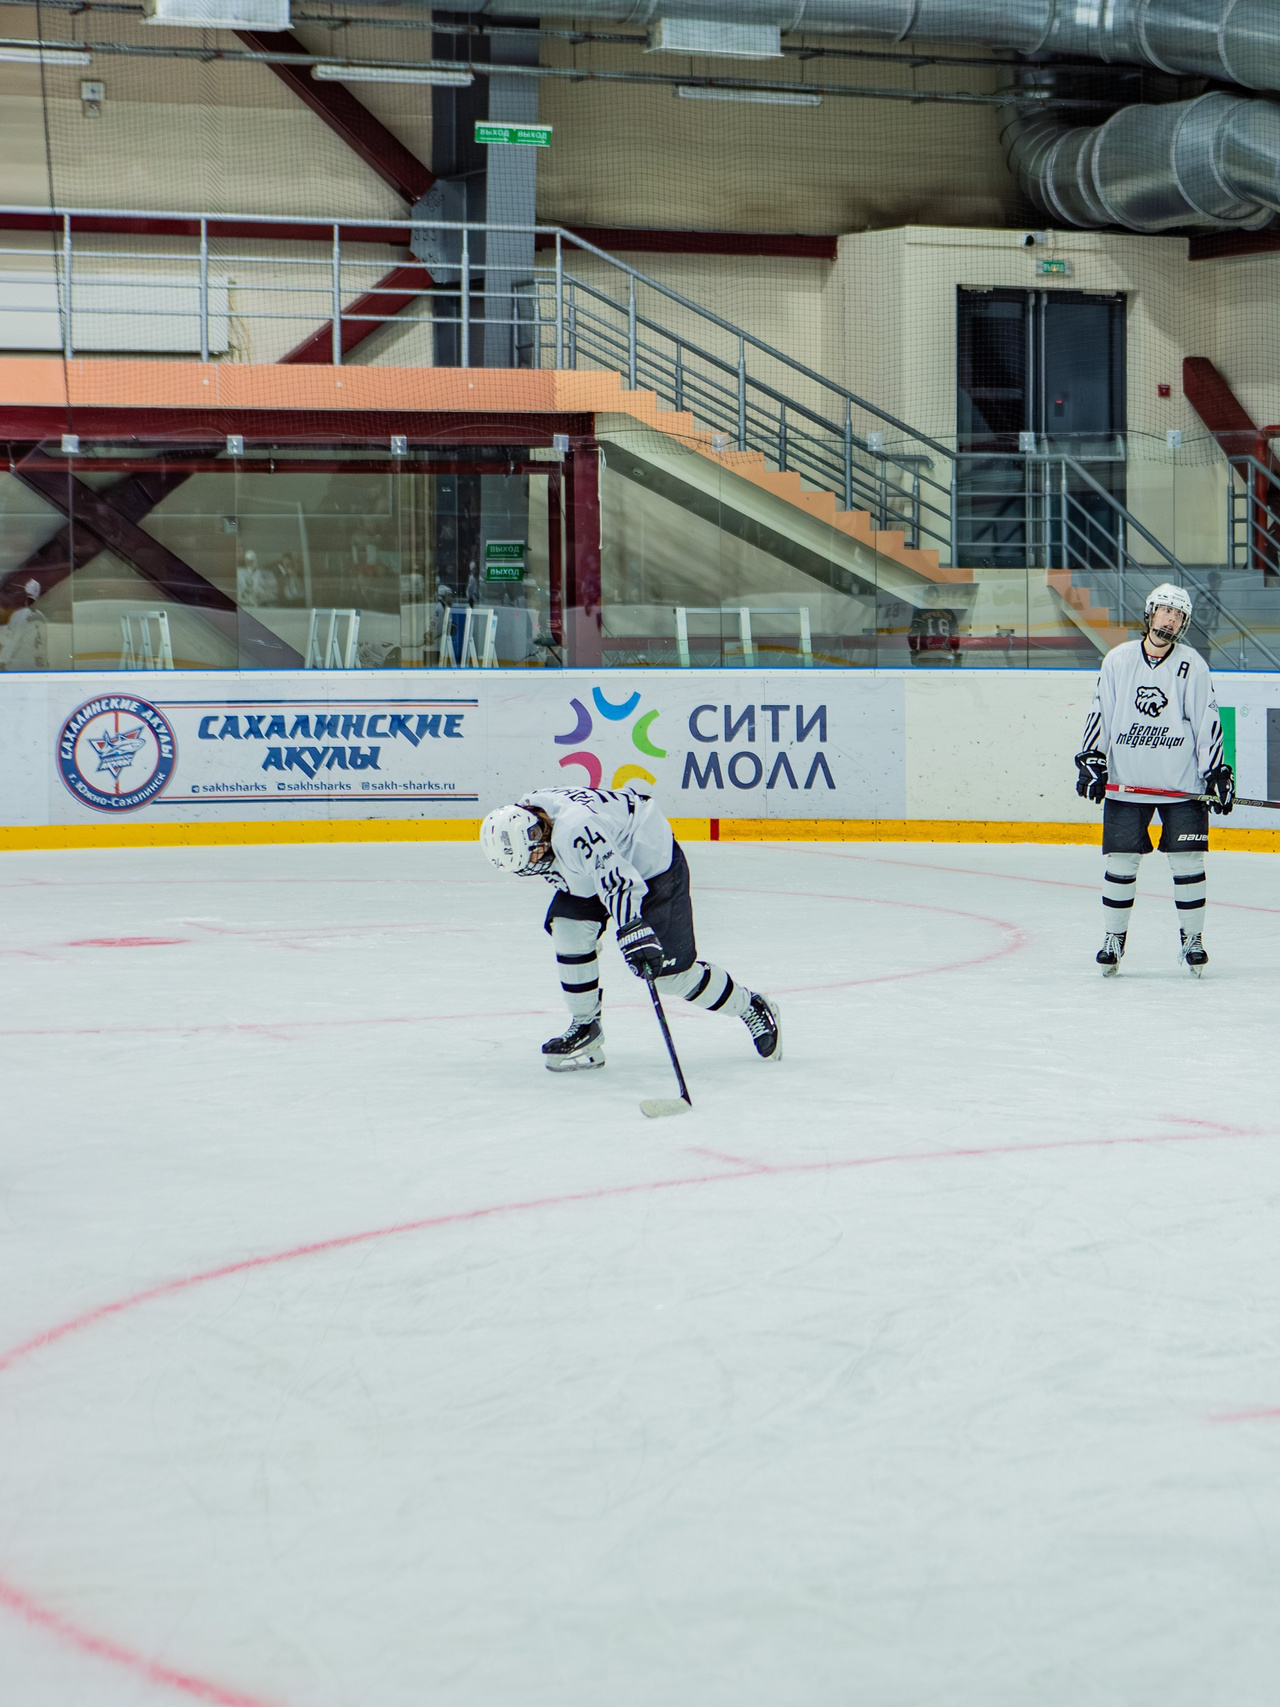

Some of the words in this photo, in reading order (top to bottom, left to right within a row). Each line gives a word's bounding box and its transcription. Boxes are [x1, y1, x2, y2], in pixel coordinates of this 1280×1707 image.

[480, 129, 509, 137] ВЫХОД
[518, 131, 547, 139] ВЫХОД
[490, 545, 519, 553] ВЫХОД
[490, 568, 519, 576] ВЫХОД
[60, 697, 140, 760] САХАЛИНСКИЕ
[141, 709, 173, 759] АКУЛЫ
[688, 704, 827, 743] СИТИ
[197, 714, 464, 748] САХАЛИНСКИЕ
[261, 746, 382, 780] АКУЛЫ
[1086, 757, 1108, 766] CC
[681, 751, 836, 790] МОЛЛ
[202, 782, 267, 792] sakhsharks
[287, 781, 351, 791] sakhsharks
[371, 780, 455, 792] sakh-sharks.ru
[573, 826, 607, 859] 34
[1177, 834, 1209, 842] BAUE
